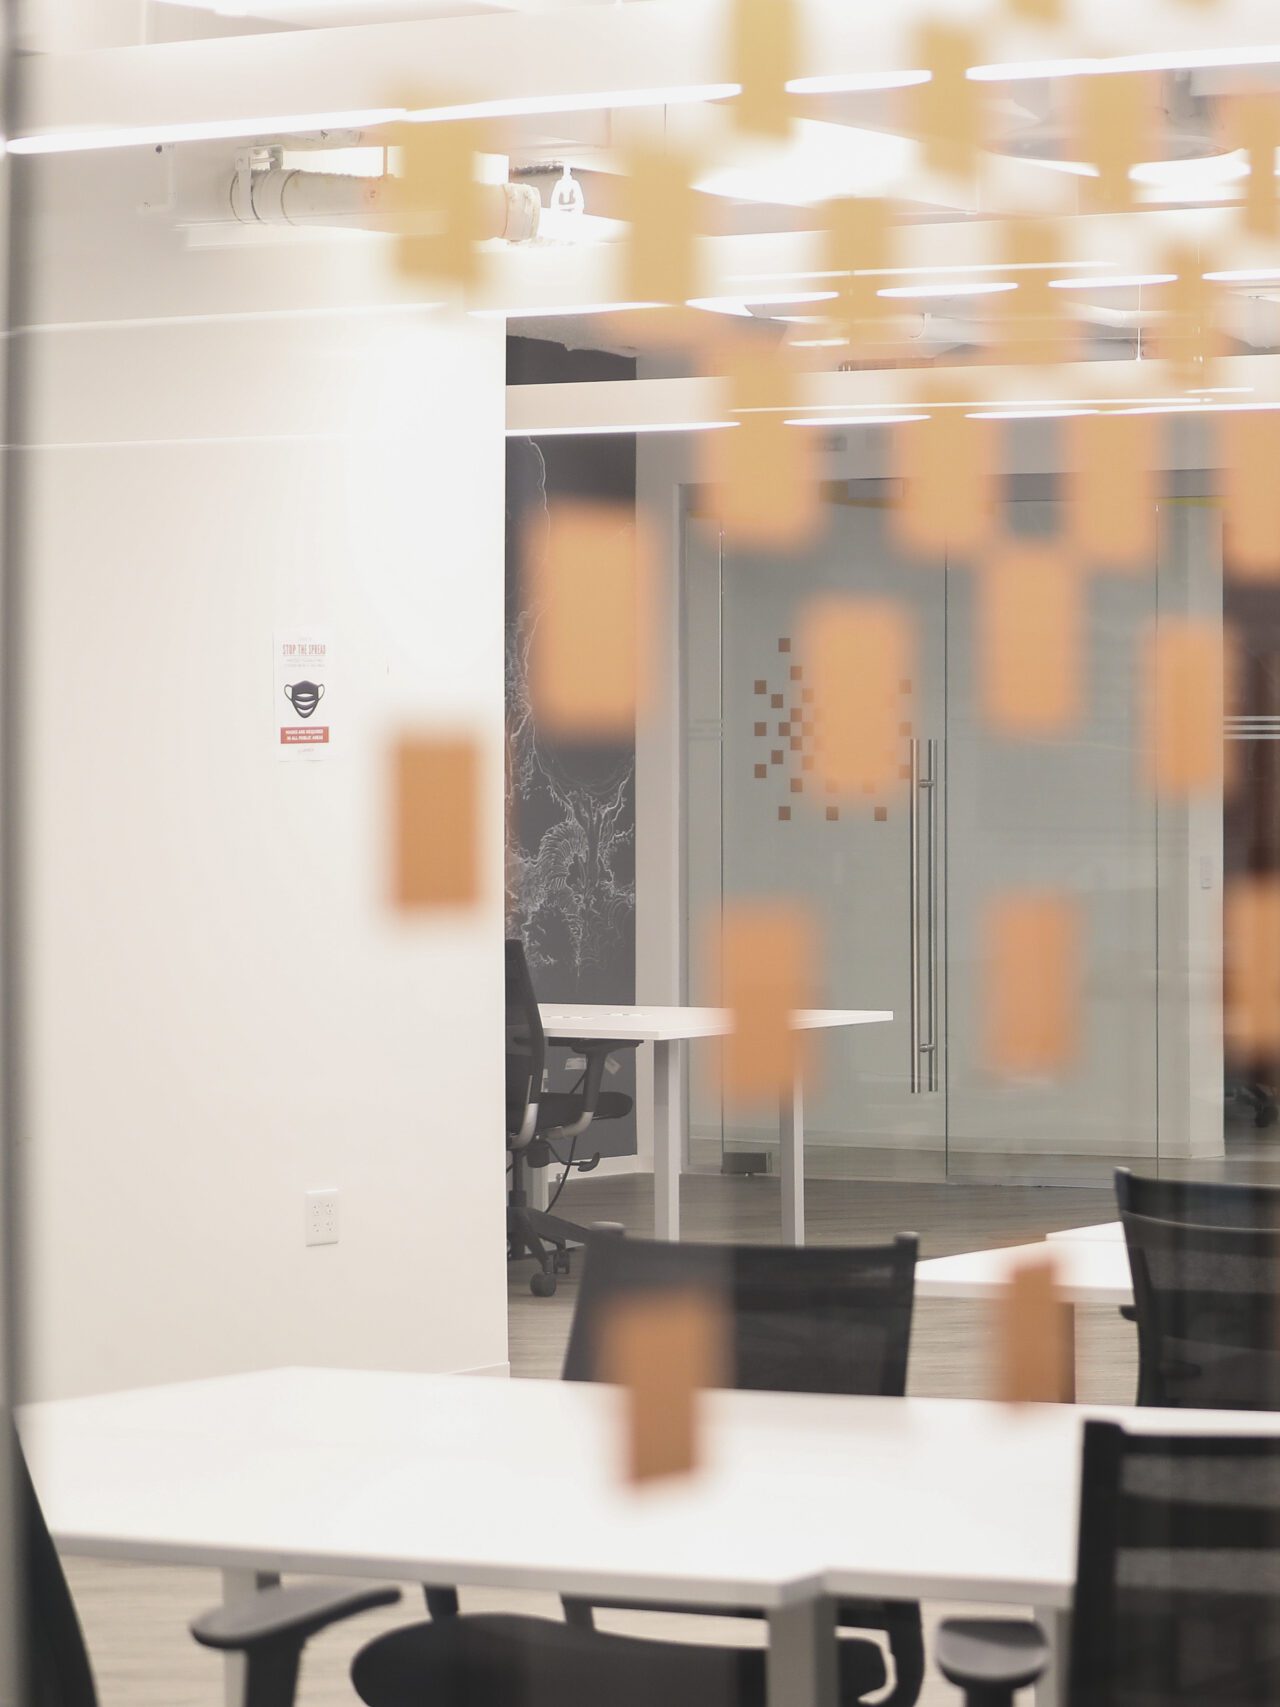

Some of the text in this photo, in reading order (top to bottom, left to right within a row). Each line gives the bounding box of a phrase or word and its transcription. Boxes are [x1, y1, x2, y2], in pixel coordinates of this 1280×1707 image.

[282, 644, 326, 655] STOP THE SPREAD
